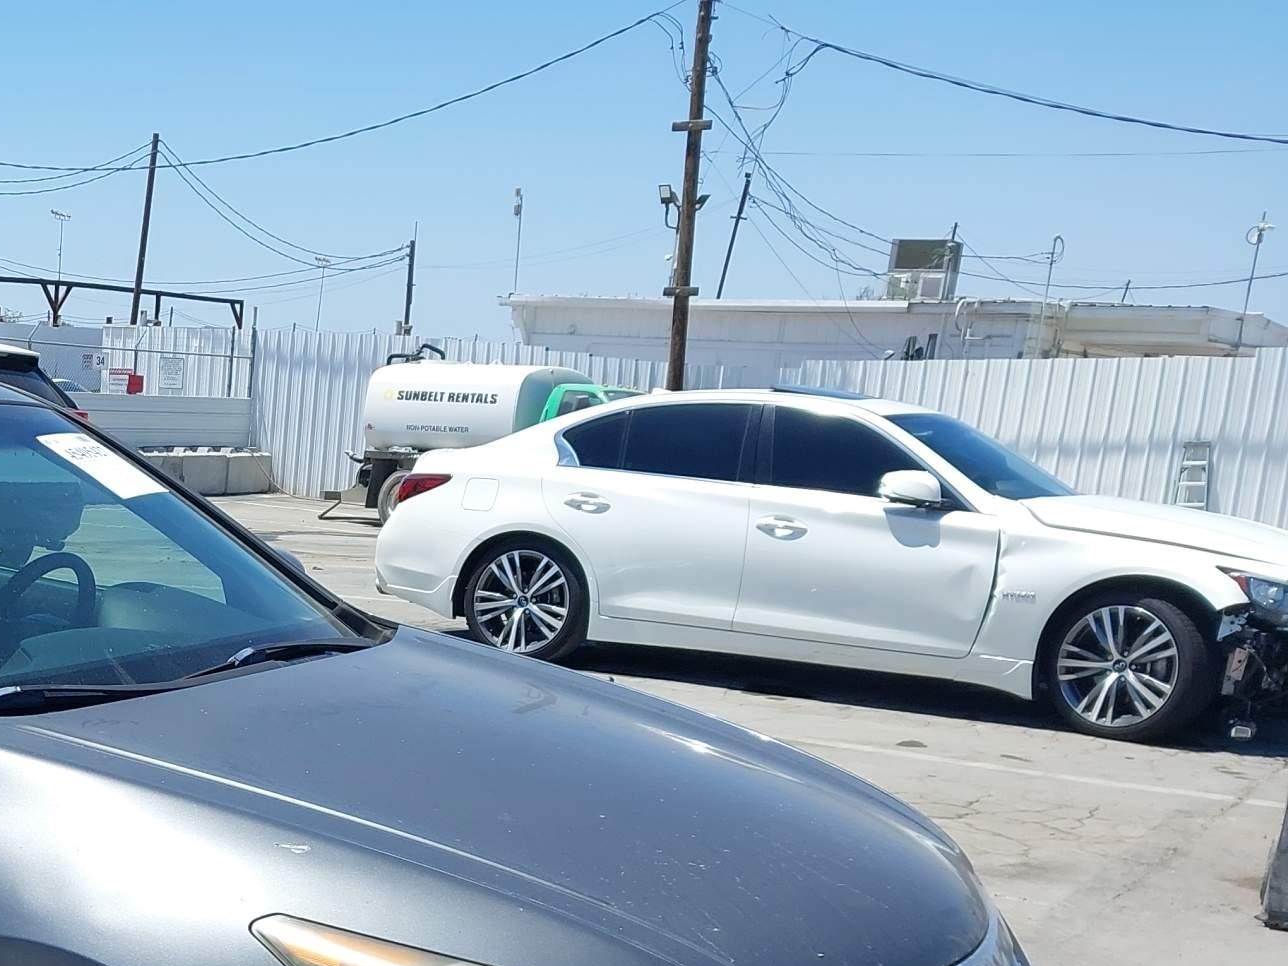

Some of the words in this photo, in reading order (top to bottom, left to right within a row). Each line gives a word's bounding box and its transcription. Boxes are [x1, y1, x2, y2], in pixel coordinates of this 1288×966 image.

[96, 355, 105, 366] 34
[397, 390, 445, 403] SUNBELT
[447, 392, 499, 404] RENTALS
[448, 425, 469, 434] WATER
